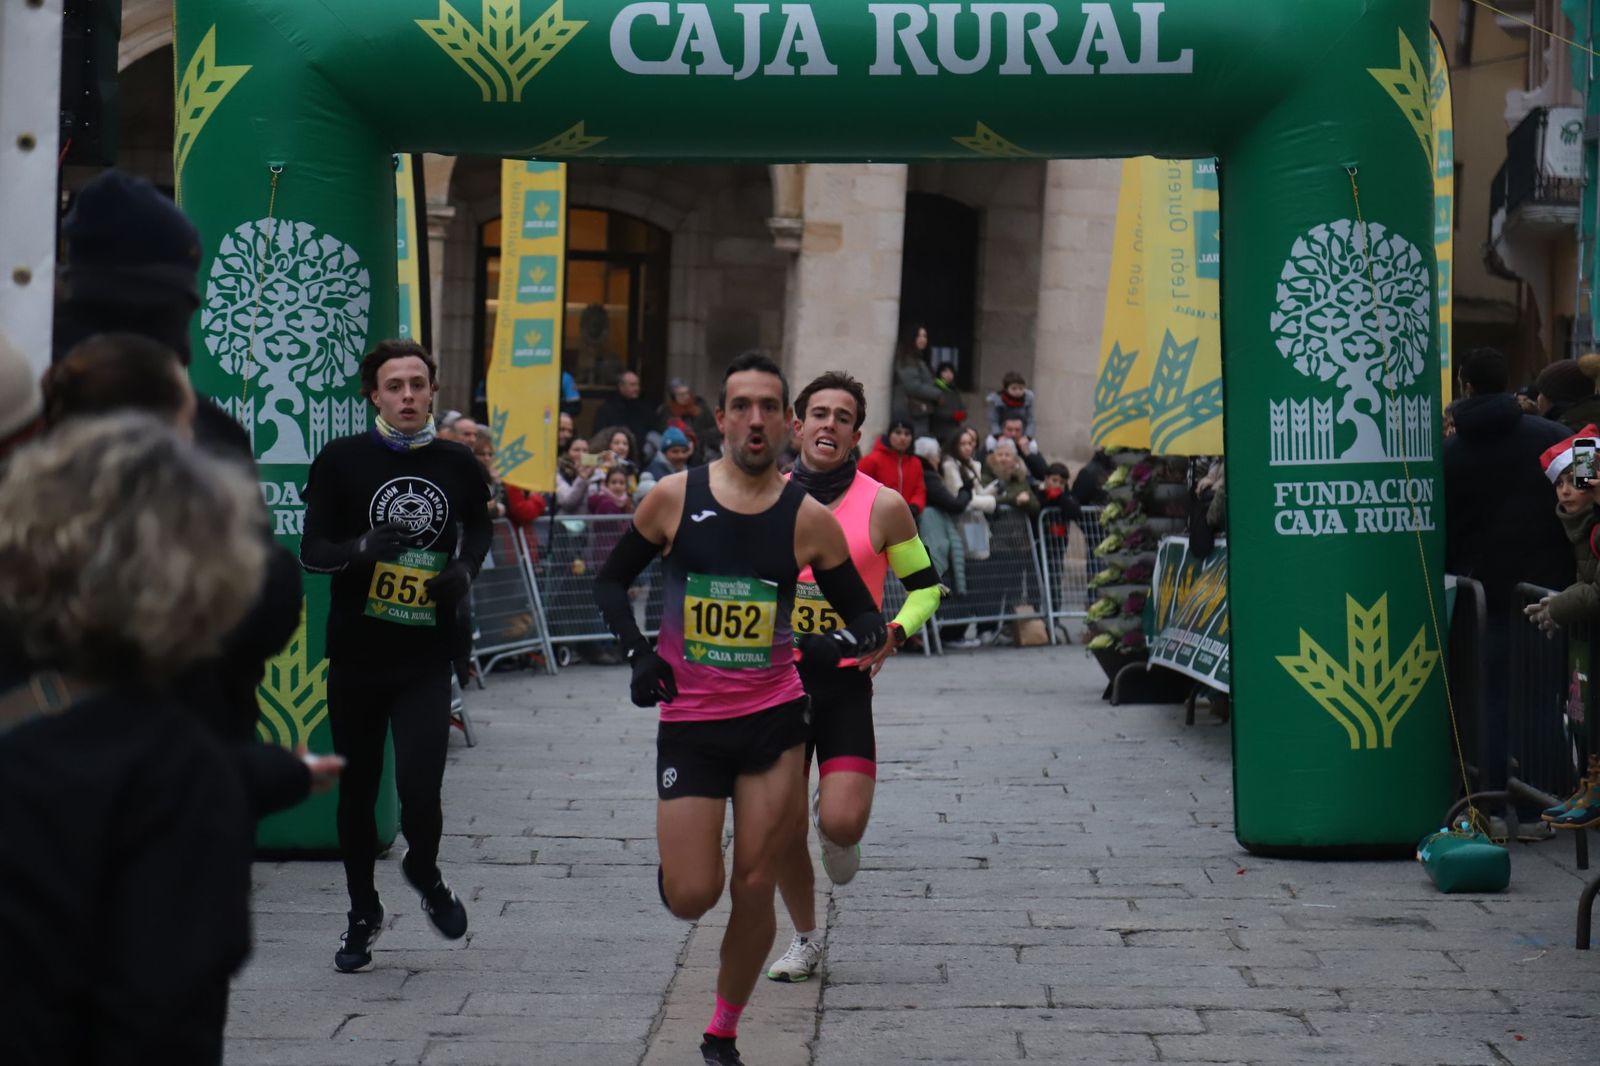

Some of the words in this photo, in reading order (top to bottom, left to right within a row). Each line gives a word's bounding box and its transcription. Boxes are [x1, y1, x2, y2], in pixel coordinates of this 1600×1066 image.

[609, 1, 838, 80] CAJA
[868, 1, 1194, 76] RURAL
[376, 484, 399, 522] NATACIÓN
[423, 486, 444, 521] ZAMORA
[1273, 478, 1434, 507] FUNDACION
[1274, 509, 1349, 537] CAJA
[1354, 506, 1436, 533] RURAL
[388, 607, 410, 620] CAJA
[411, 611, 432, 621] RURAL
[691, 601, 761, 639] 1052
[707, 649, 732, 662] CAJA
[734, 652, 767, 663] RURAL
